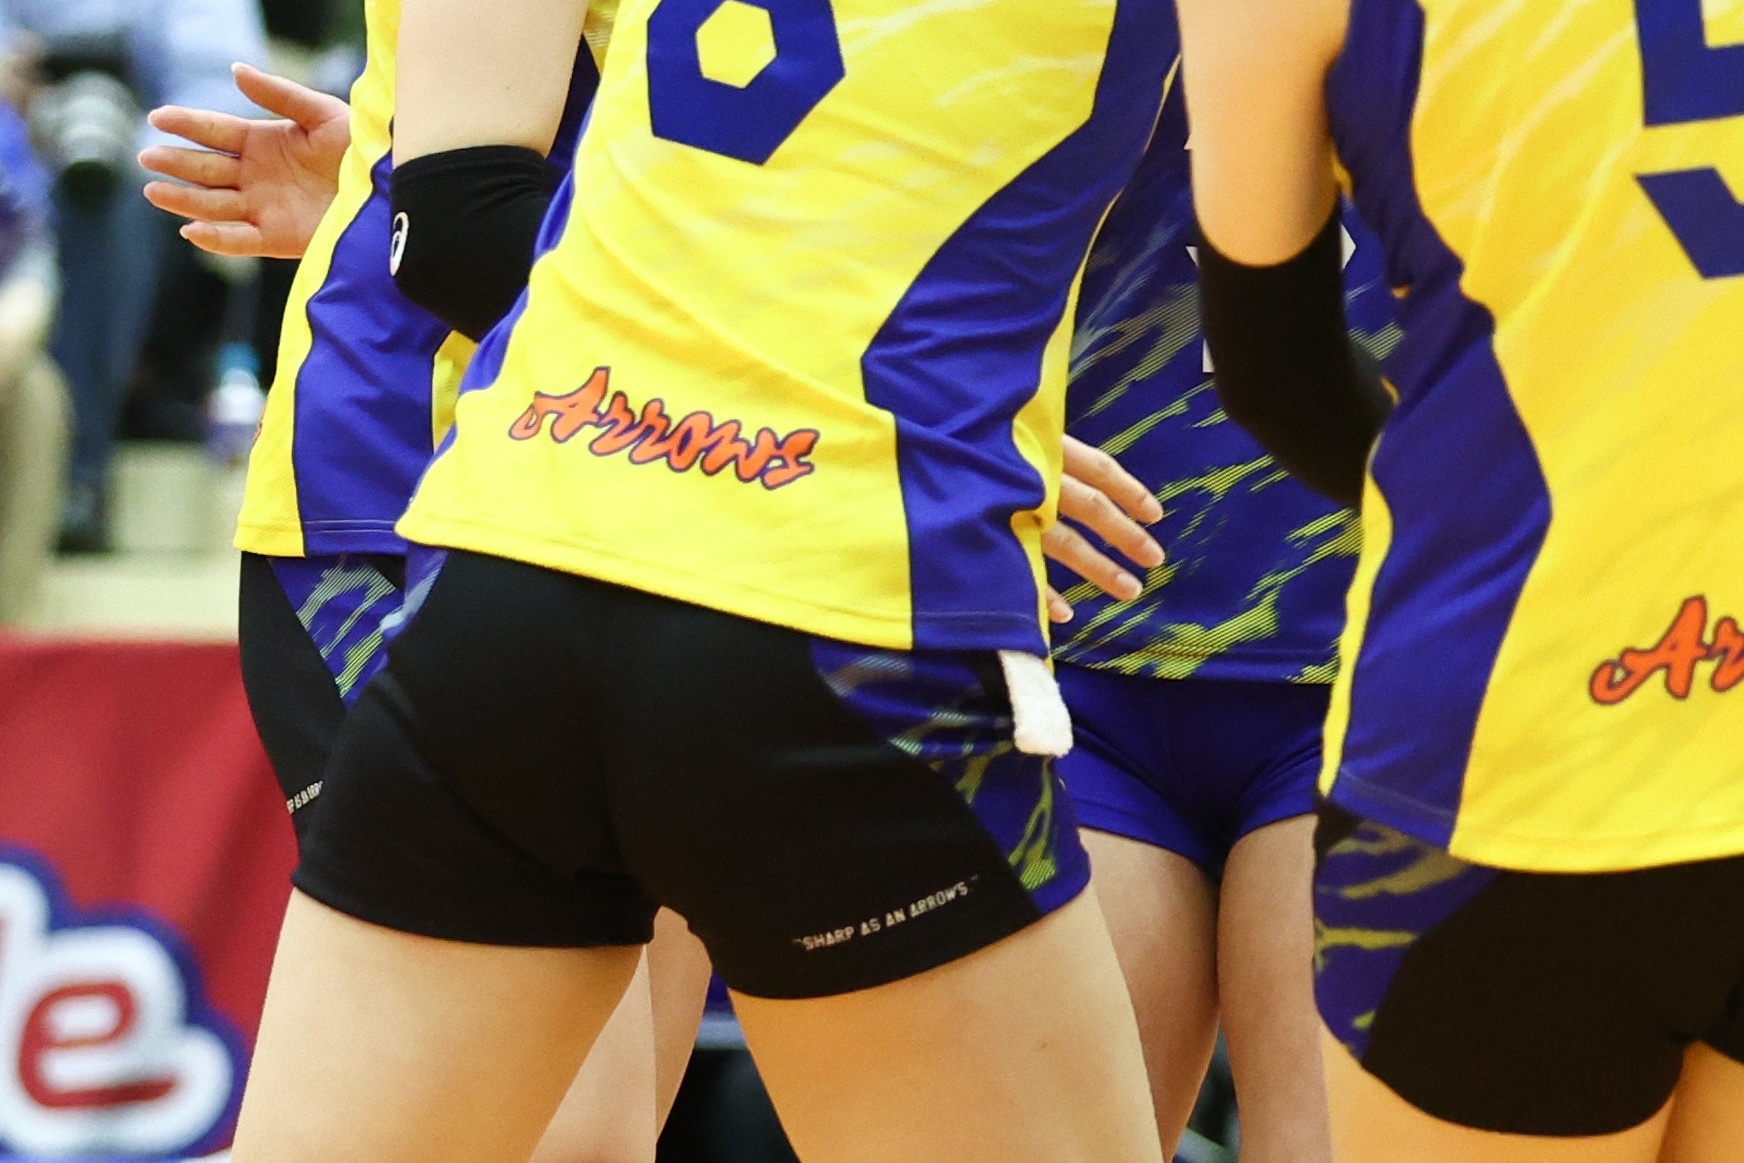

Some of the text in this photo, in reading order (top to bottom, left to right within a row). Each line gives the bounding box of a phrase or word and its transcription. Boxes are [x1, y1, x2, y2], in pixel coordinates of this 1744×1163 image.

[508, 366, 820, 490] Arrows
[860, 917, 881, 936] AS
[885, 907, 907, 927] AN
